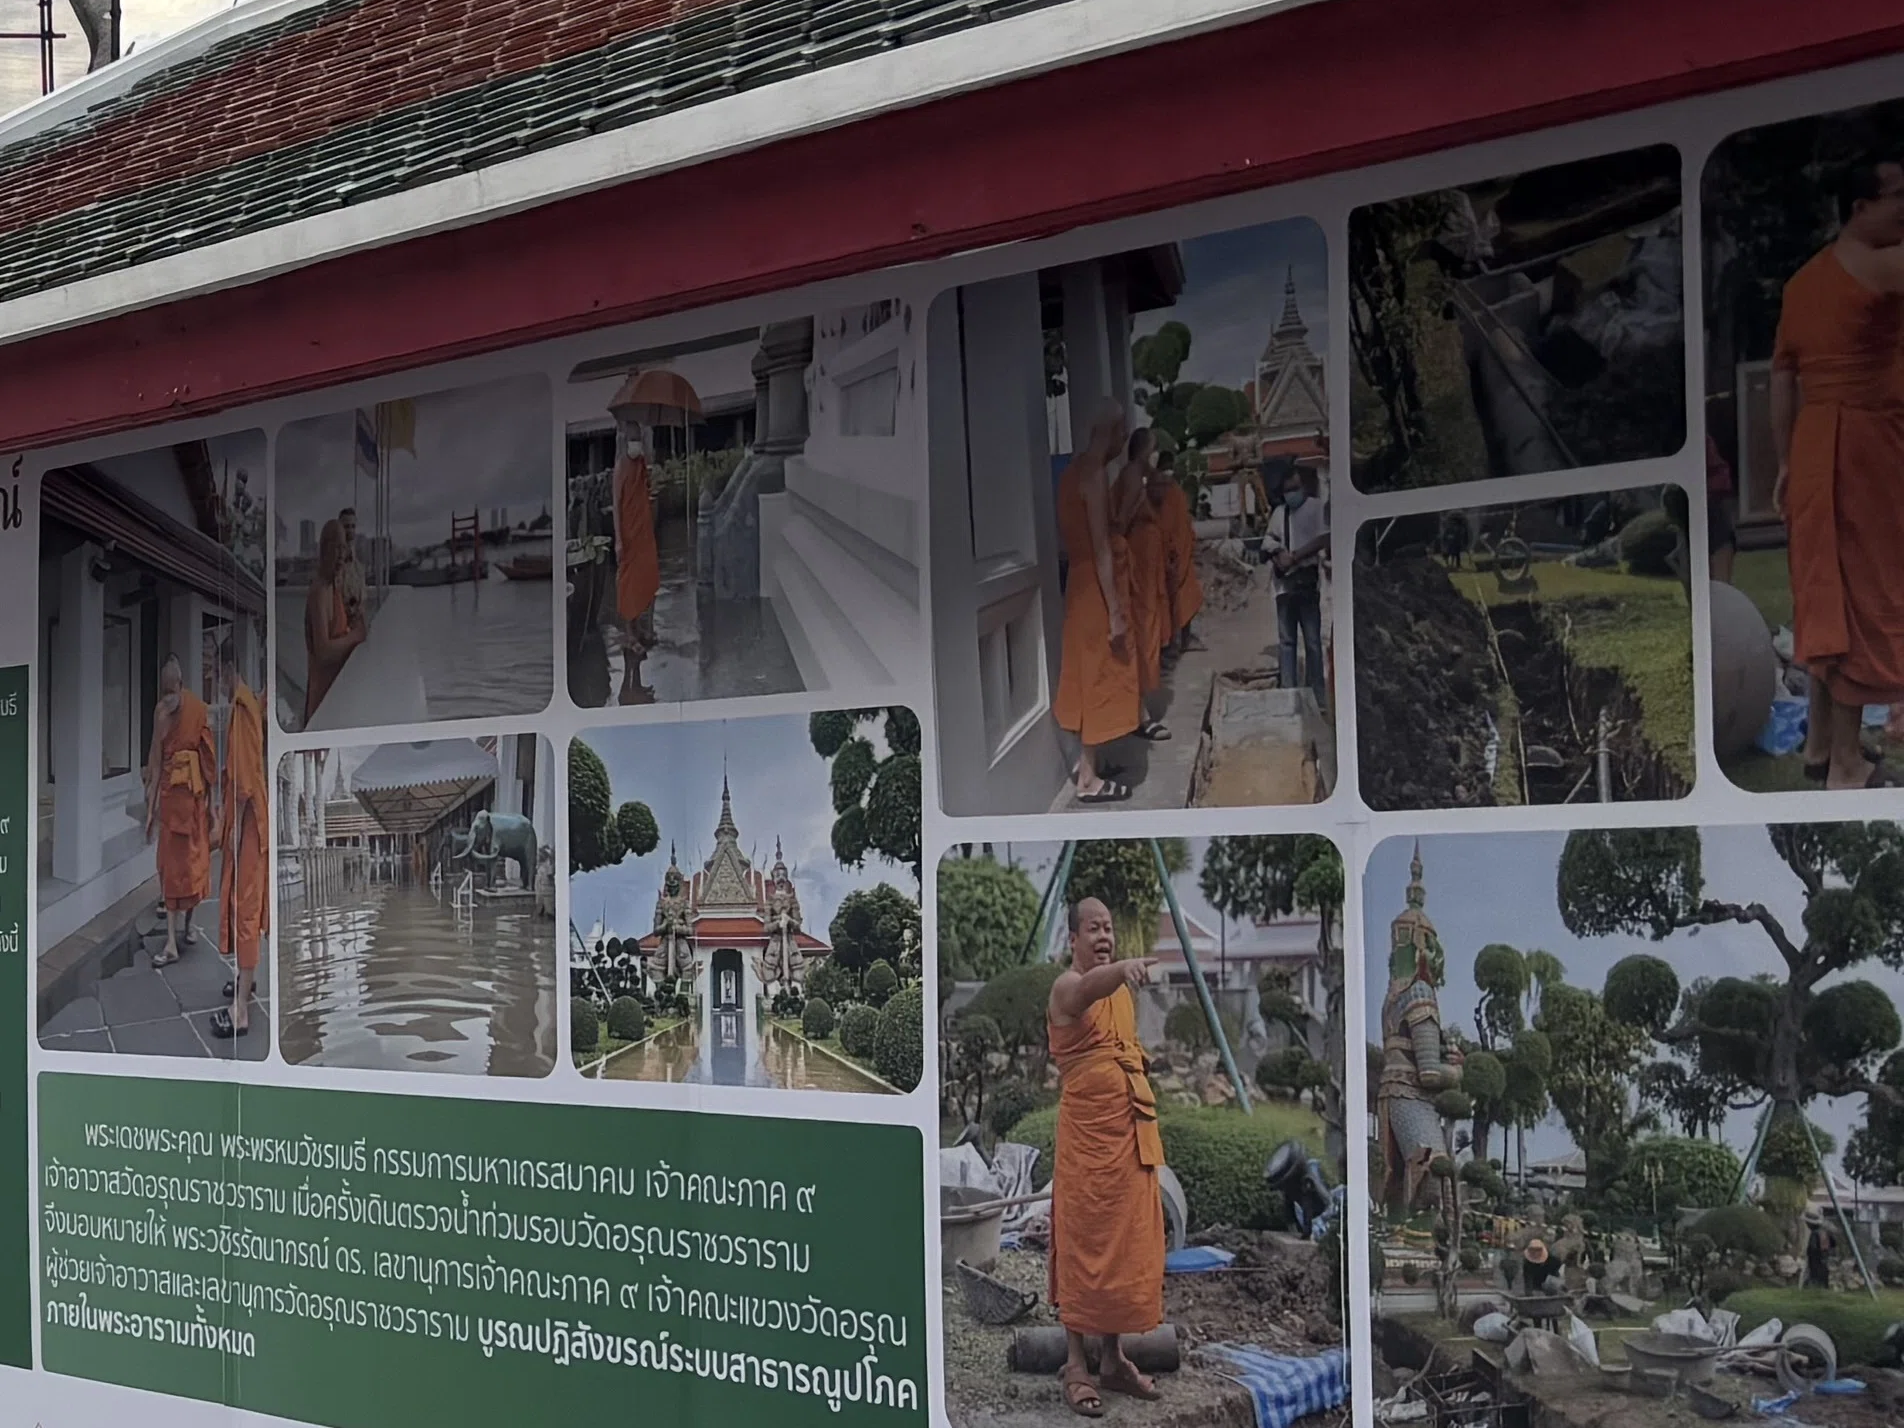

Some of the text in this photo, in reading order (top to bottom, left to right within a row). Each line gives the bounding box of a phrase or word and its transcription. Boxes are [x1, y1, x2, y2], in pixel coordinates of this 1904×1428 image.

[0, 817, 10, 834] ๙
[45, 1157, 810, 1273] เจ้าอาวาสวัดอรุณราชวราราม เมื่อครั้งเดินตรวจน้ำท่วมรอบวัดอรุณราชวราราม
[85, 1123, 816, 1213] พระเดชพระคุณ พระพรหมวัชรเมธี กรรมการมหาเถรสมาคม เจ้าคณะภาค ๙
[44, 1202, 906, 1354] จึงมอบหมายให้ พระวชิรรัตนาภรณ์ ดร. เลขานุการเจ้าคณะภาค ๙ เจ้าคณะแขวงวัดอรุณ
[47, 1292, 255, 1357] ภายในพระอารามทั้งหมด
[46, 1248, 917, 1412] ผู้ช่วยเจ้าอาวาสและเลขานุการวัดอรุณราชวราราม บูรณปฏิสังขรณ์ระบบสาธารณูปโภค
